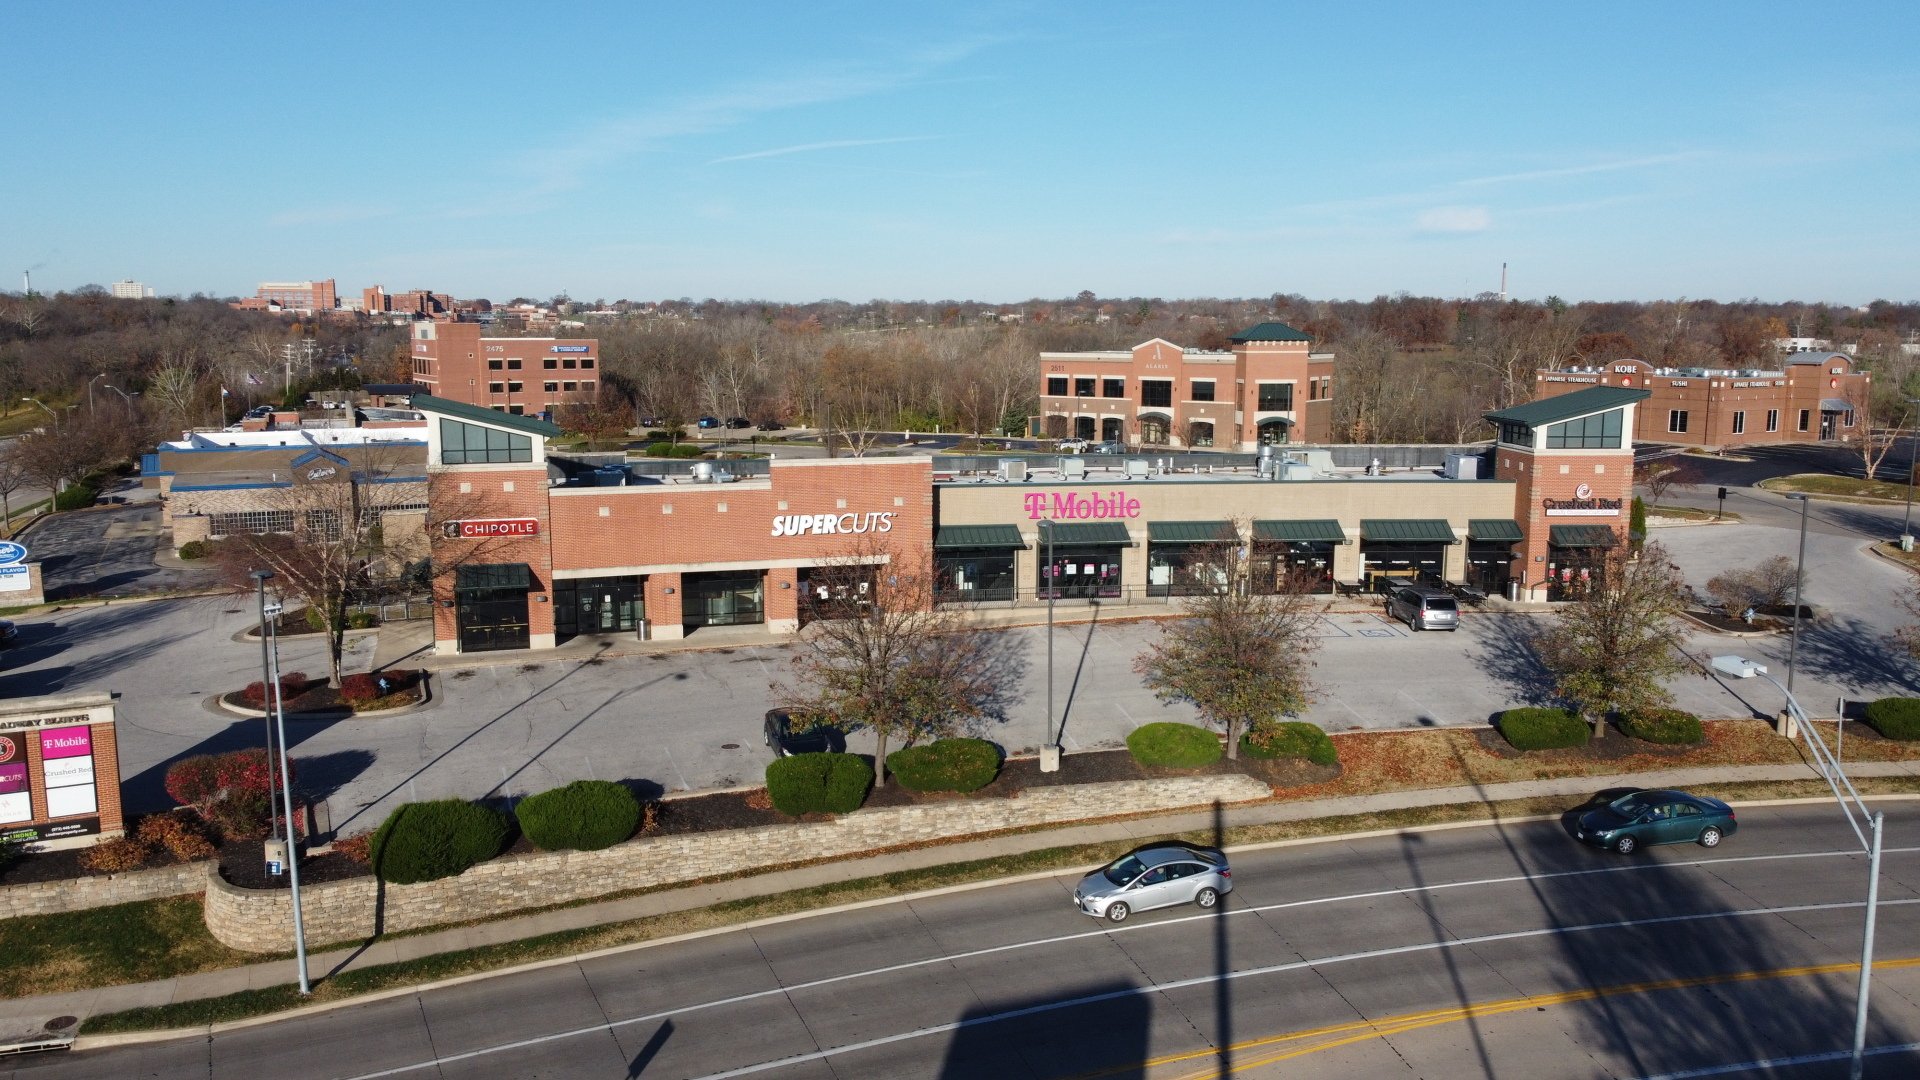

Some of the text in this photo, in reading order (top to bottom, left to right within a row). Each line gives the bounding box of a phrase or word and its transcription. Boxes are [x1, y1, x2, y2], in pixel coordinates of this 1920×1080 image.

[1614, 365, 1638, 374] KOBE
[1051, 491, 1141, 519] Mobile
[1543, 498, 1623, 509] Crushed Red
[464, 523, 534, 534] CHIPOTLE
[771, 512, 894, 537] SUPERCUTS
[54, 736, 88, 748] Mobile
[45, 766, 92, 777] Crushed Red
